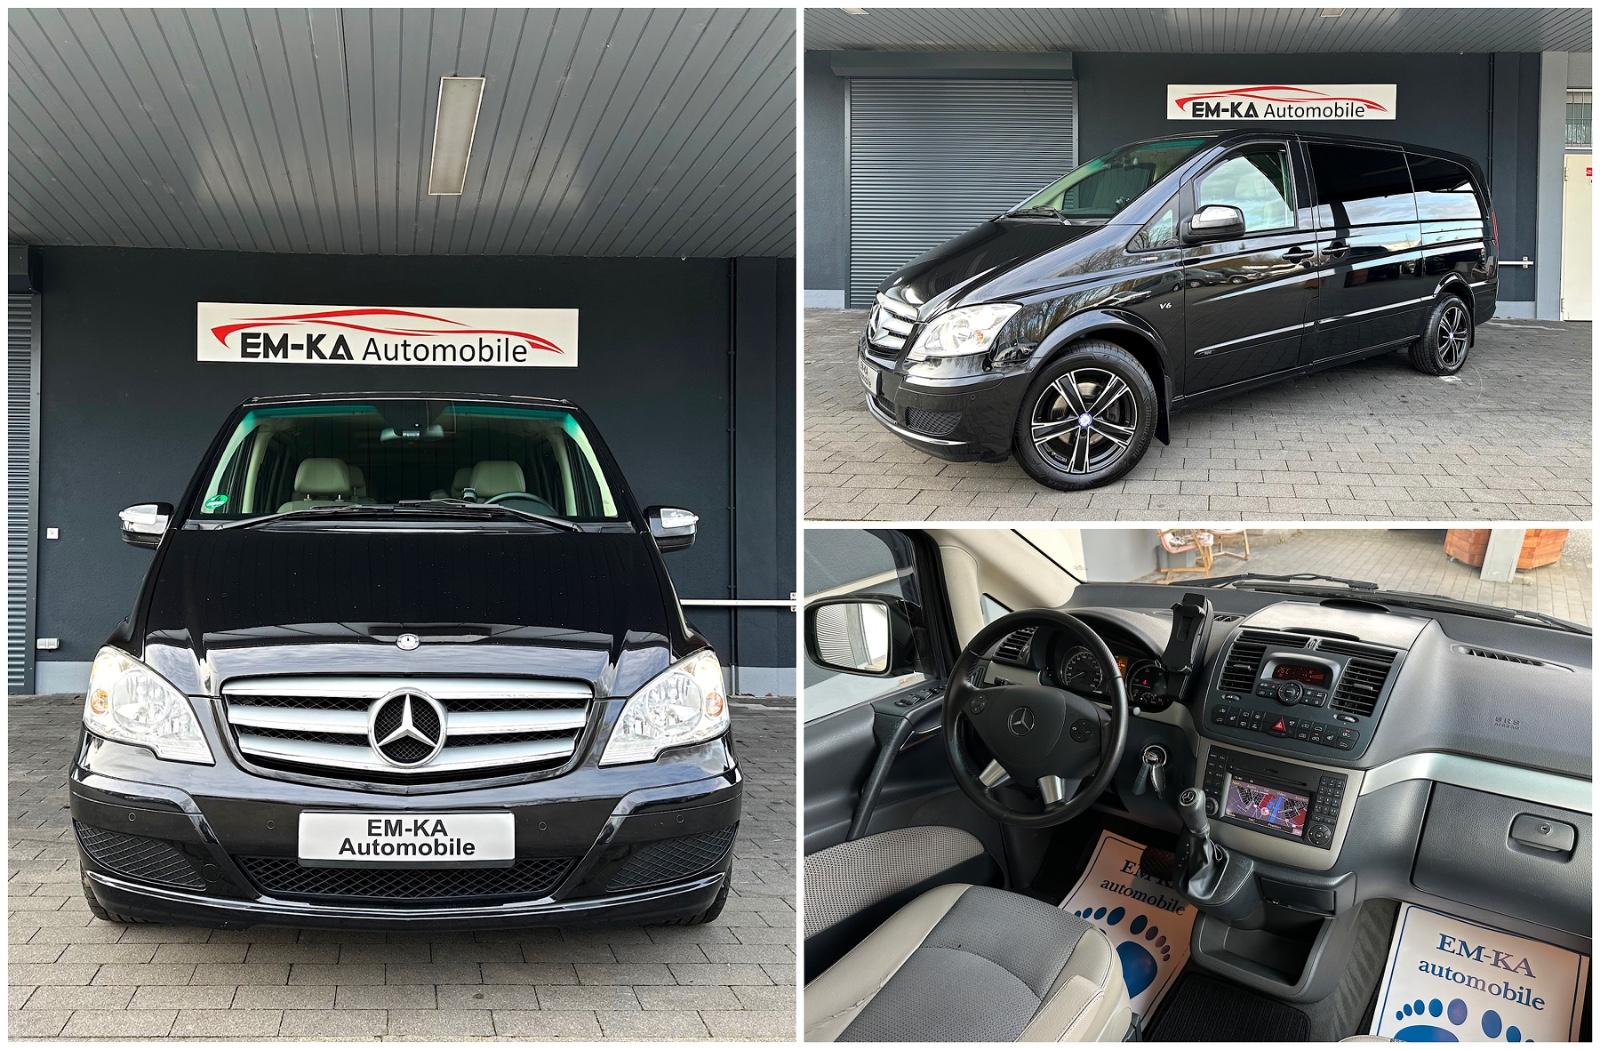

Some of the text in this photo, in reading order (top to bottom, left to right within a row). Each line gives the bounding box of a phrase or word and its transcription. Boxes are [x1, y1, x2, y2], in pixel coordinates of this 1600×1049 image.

[1191, 101, 1365, 118] EM-KA Automobile
[240, 332, 528, 363] EM-KA Automobile
[367, 819, 448, 837] EM-KA
[338, 837, 476, 856] Automobile
[1100, 878, 1186, 916] automobile
[1436, 933, 1537, 979] EM-KA
[1418, 959, 1546, 1011] automobile
